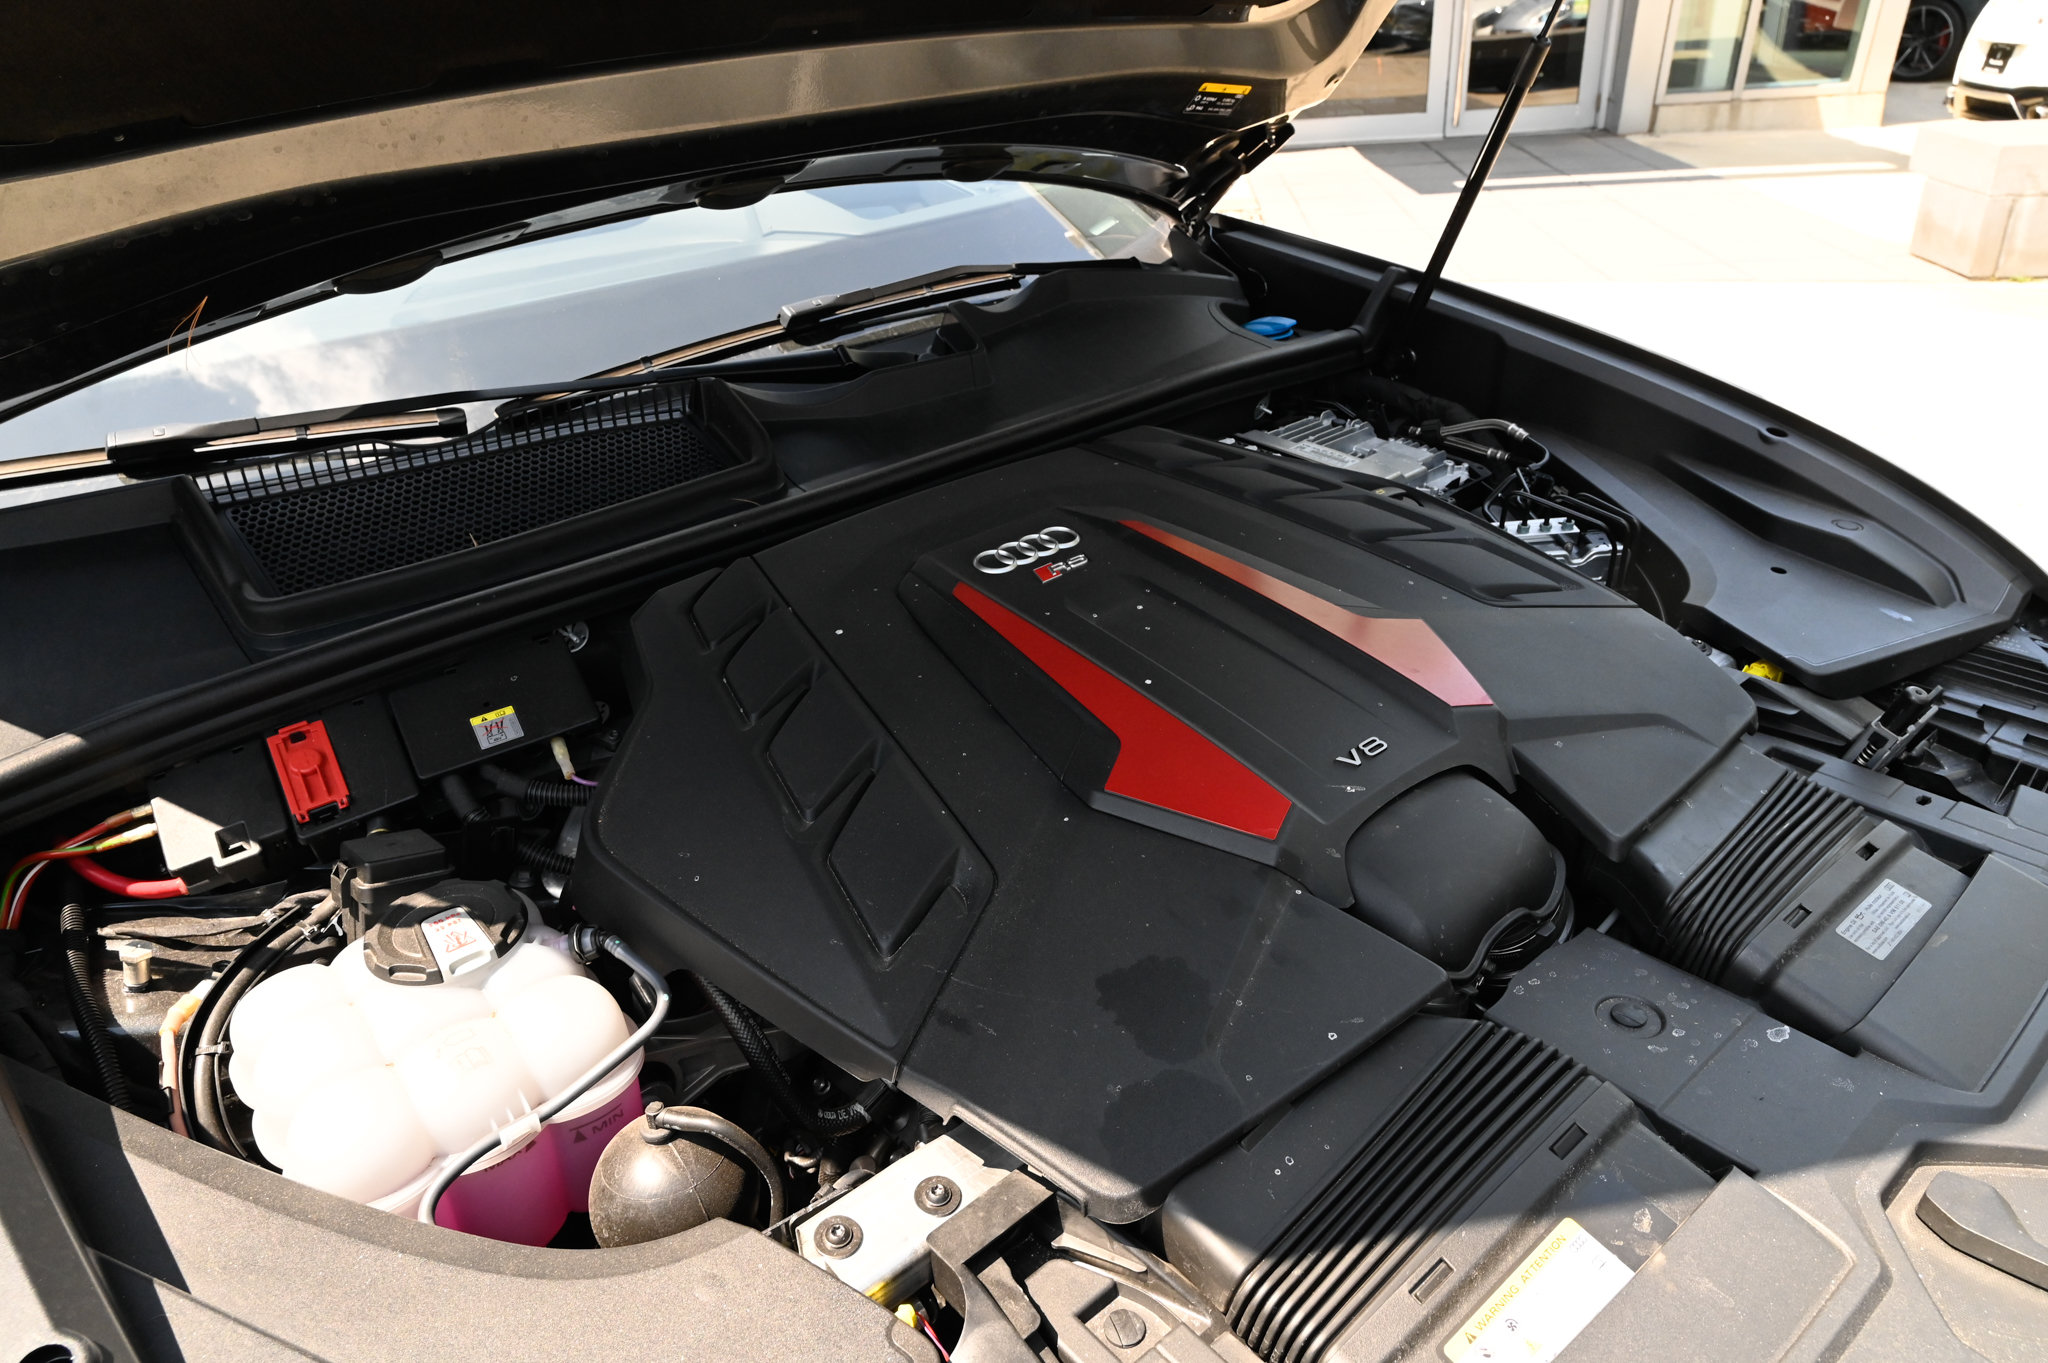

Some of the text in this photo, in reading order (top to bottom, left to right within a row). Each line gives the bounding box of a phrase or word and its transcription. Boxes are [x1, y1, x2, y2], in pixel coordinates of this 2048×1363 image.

[1044, 553, 1088, 577] RS
[1335, 736, 1388, 766] V8
[592, 1109, 624, 1134] MIN
[1475, 1234, 1567, 1332] WARNING ATTENTION
